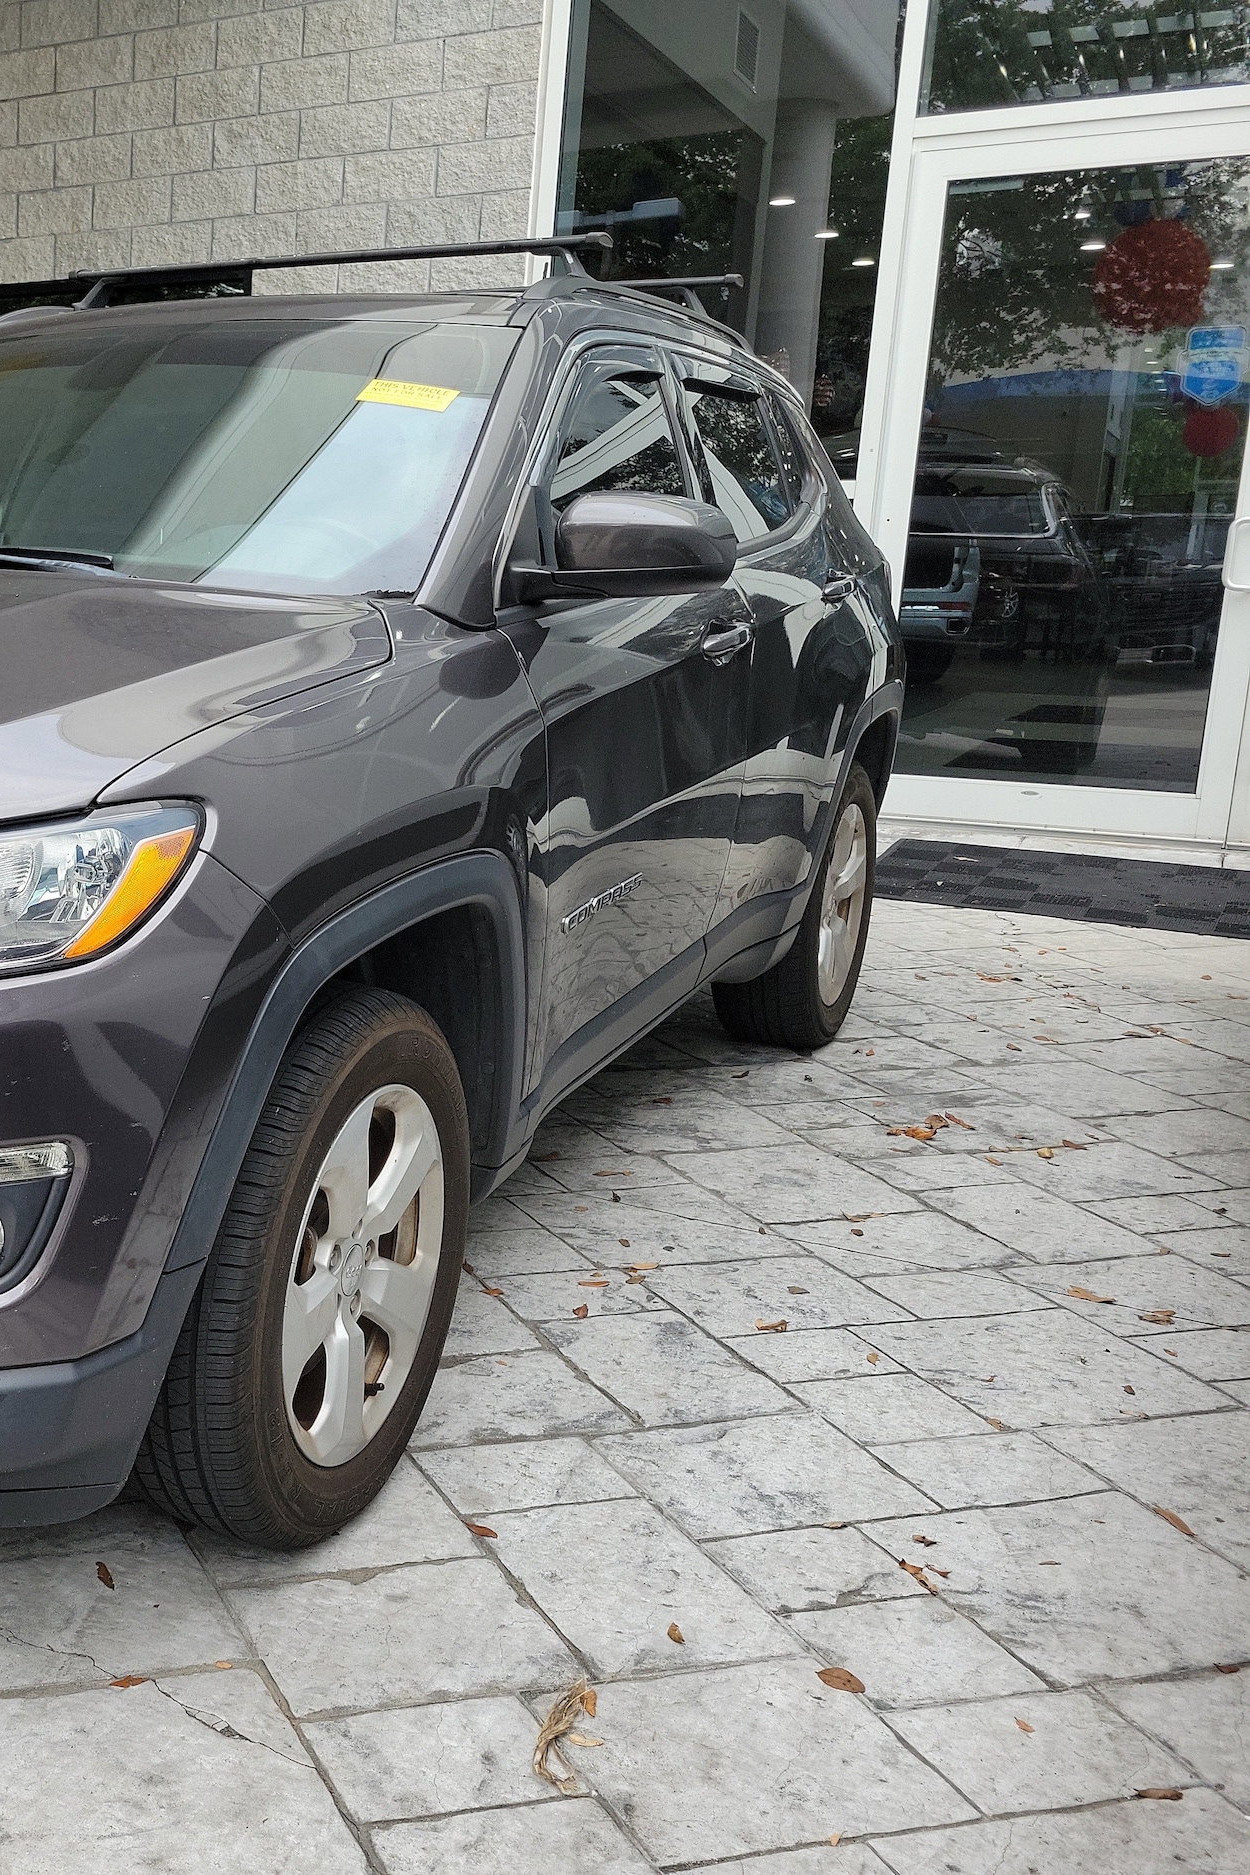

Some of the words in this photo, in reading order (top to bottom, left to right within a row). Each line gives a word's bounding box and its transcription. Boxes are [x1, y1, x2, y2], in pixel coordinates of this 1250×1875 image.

[374, 381, 399, 389] THIS
[402, 385, 451, 396] VEHICLE
[560, 871, 643, 934] COMPASS
